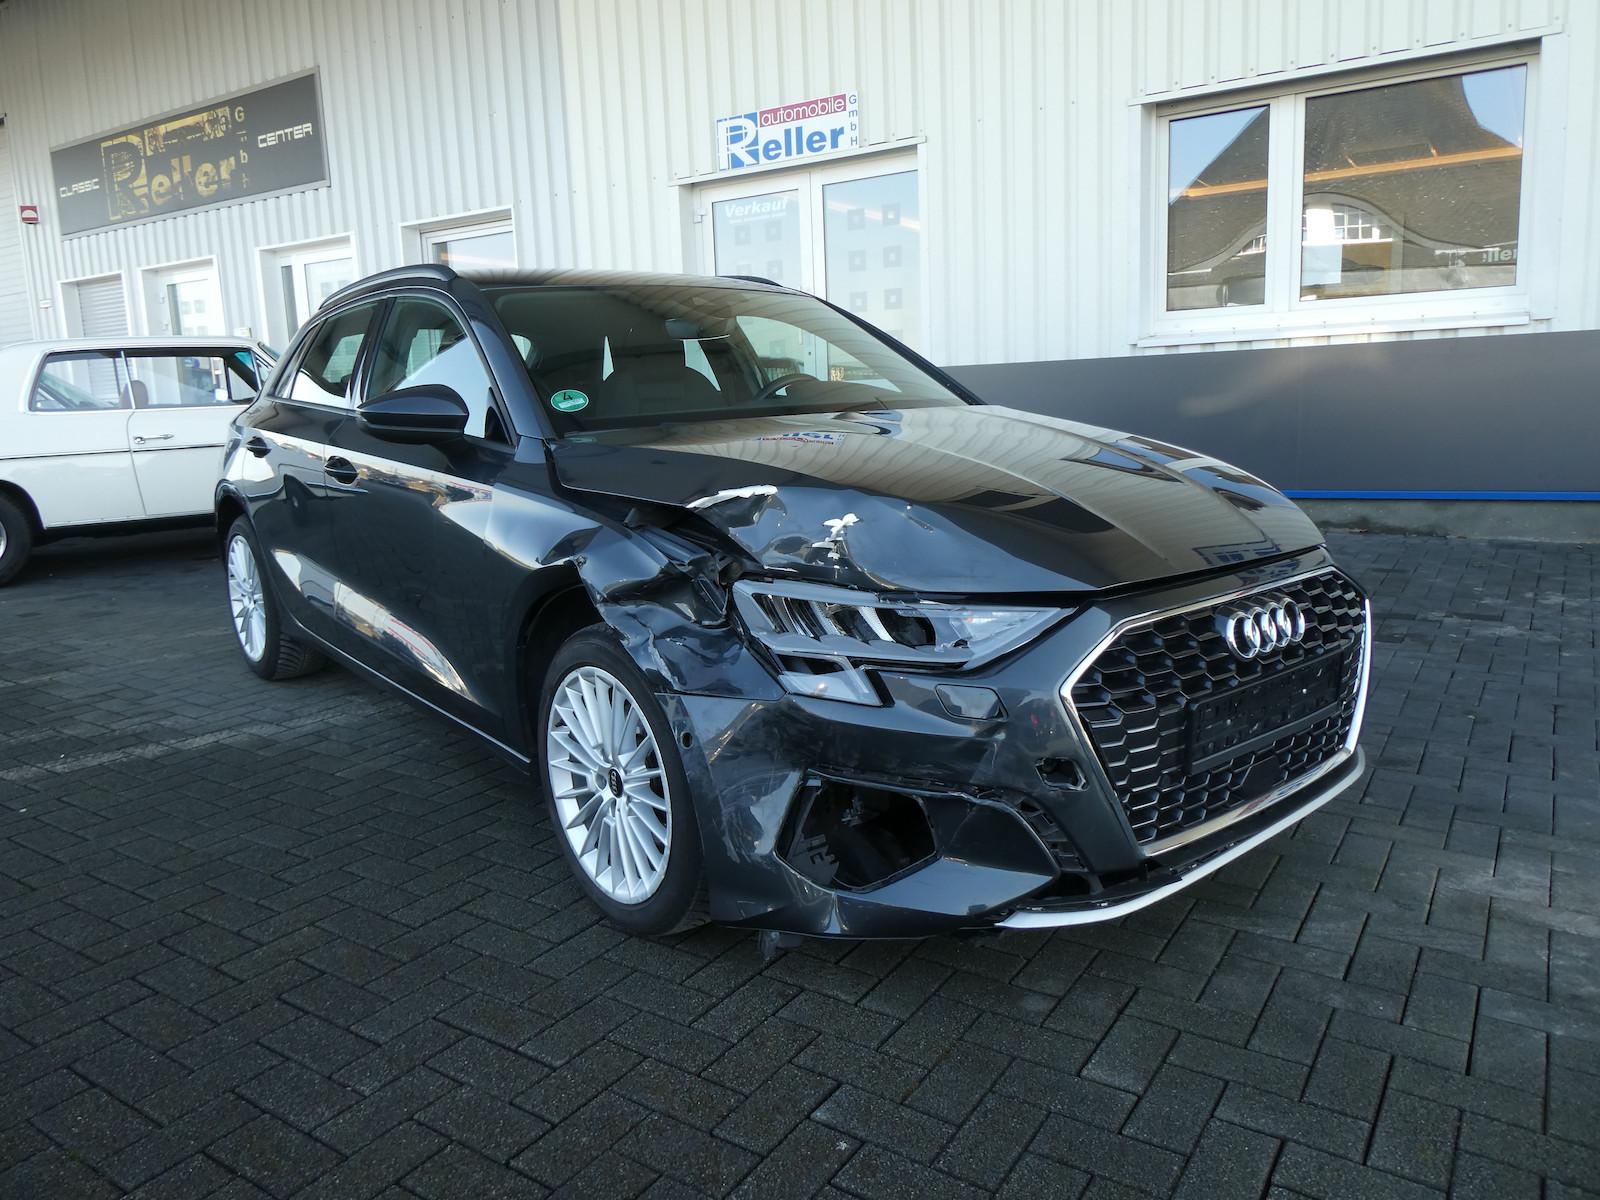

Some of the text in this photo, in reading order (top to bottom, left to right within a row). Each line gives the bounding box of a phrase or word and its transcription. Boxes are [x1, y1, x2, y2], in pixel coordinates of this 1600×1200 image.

[760, 97, 845, 127] automobile
[848, 94, 858, 147] GmbH
[257, 122, 313, 148] CENTER
[716, 112, 845, 171] Reller
[724, 196, 789, 218] Verkauf
